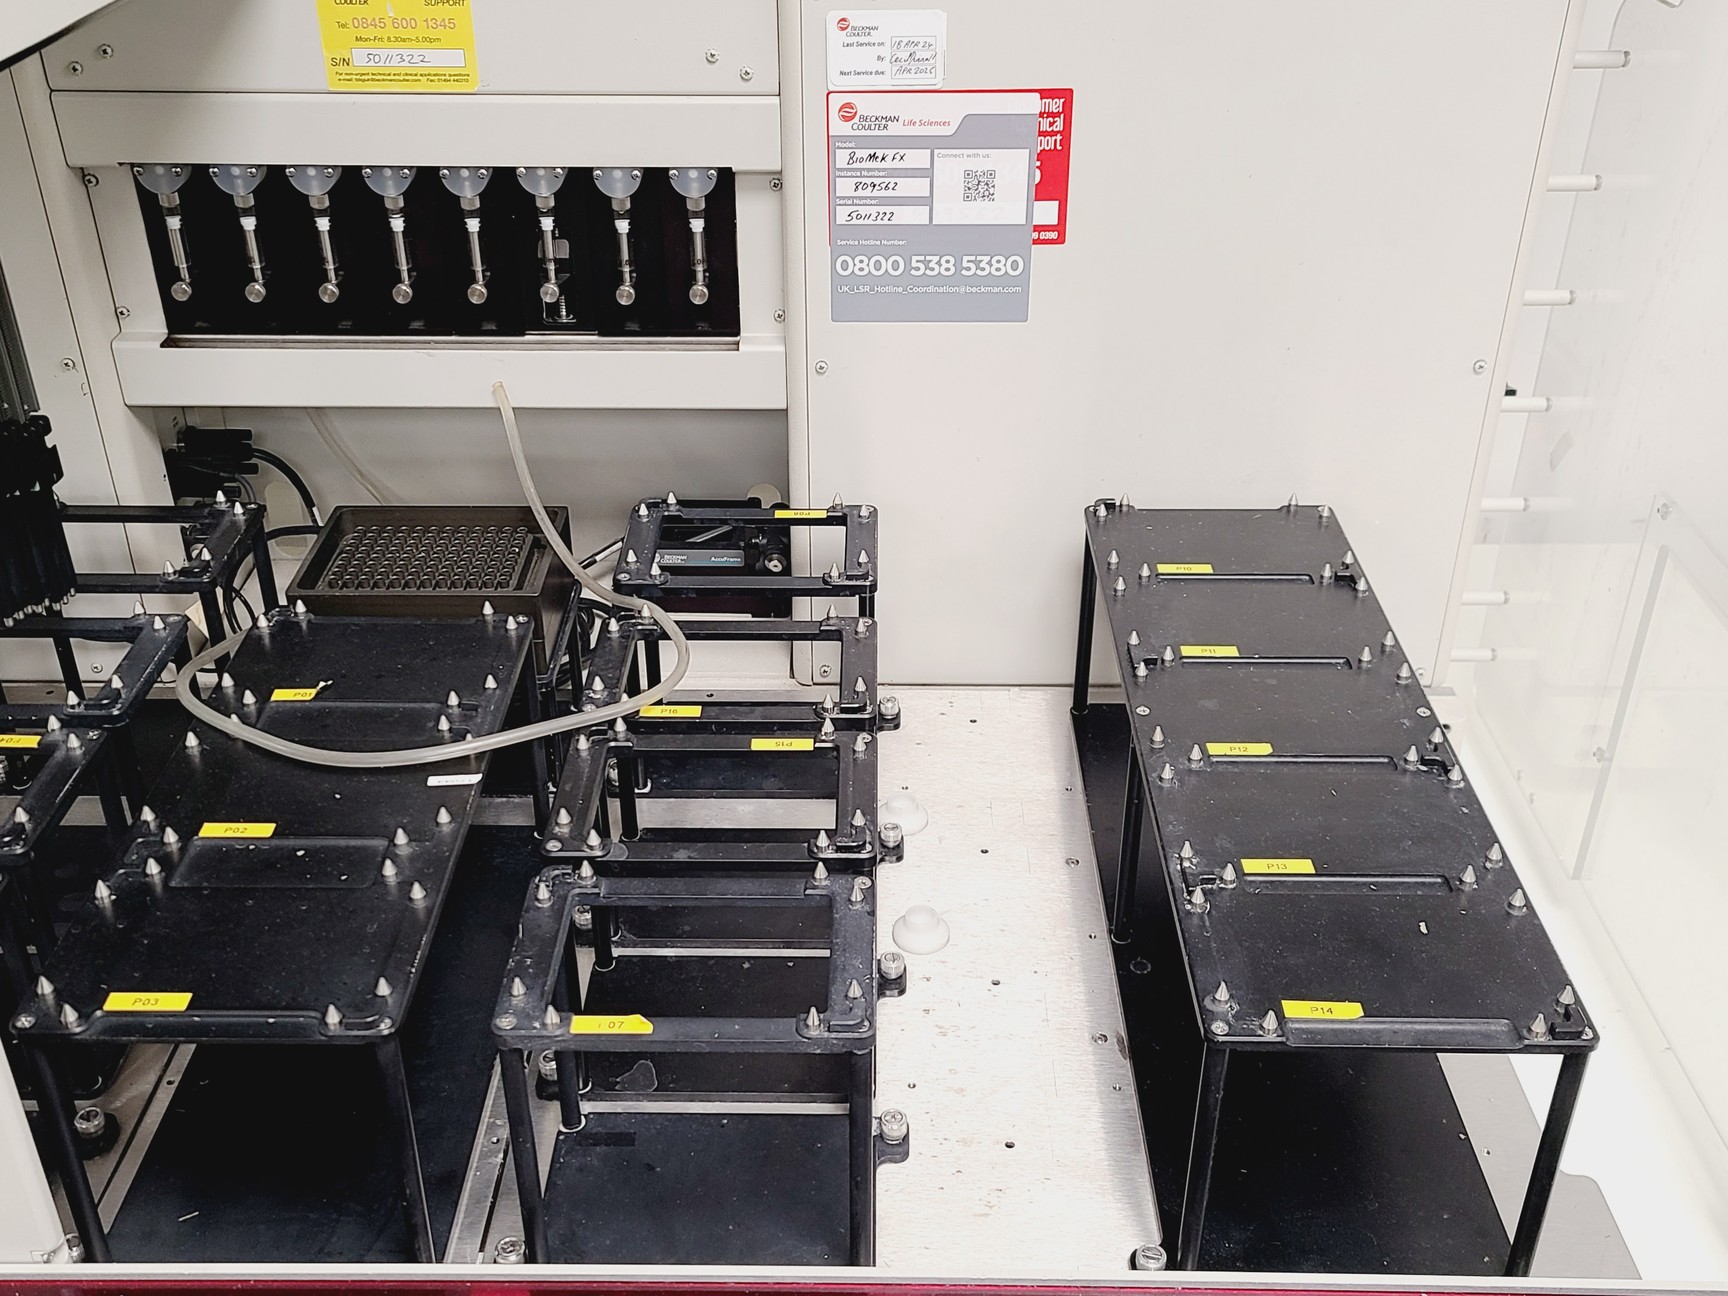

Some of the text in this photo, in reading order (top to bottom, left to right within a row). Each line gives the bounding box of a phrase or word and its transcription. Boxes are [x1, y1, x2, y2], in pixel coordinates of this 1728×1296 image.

[336, 17, 456, 30] Tel: 0845 600 1345
[892, 40, 933, 50] 18 APR 24
[331, 57, 350, 67] S/N
[366, 53, 431, 64] 5011322
[894, 66, 912, 76] APR
[851, 122, 888, 131] COULTER
[1037, 134, 1062, 154] port
[892, 152, 906, 162] FX
[854, 181, 898, 193] 809562
[845, 210, 894, 222] 5011322
[1040, 231, 1058, 240] 0390
[836, 254, 1024, 276] 0800 538 5380
[838, 285, 1022, 294] UK_LSR_Hotline_Coordination@beckman.com
[1310, 1006, 1333, 1014] P14
